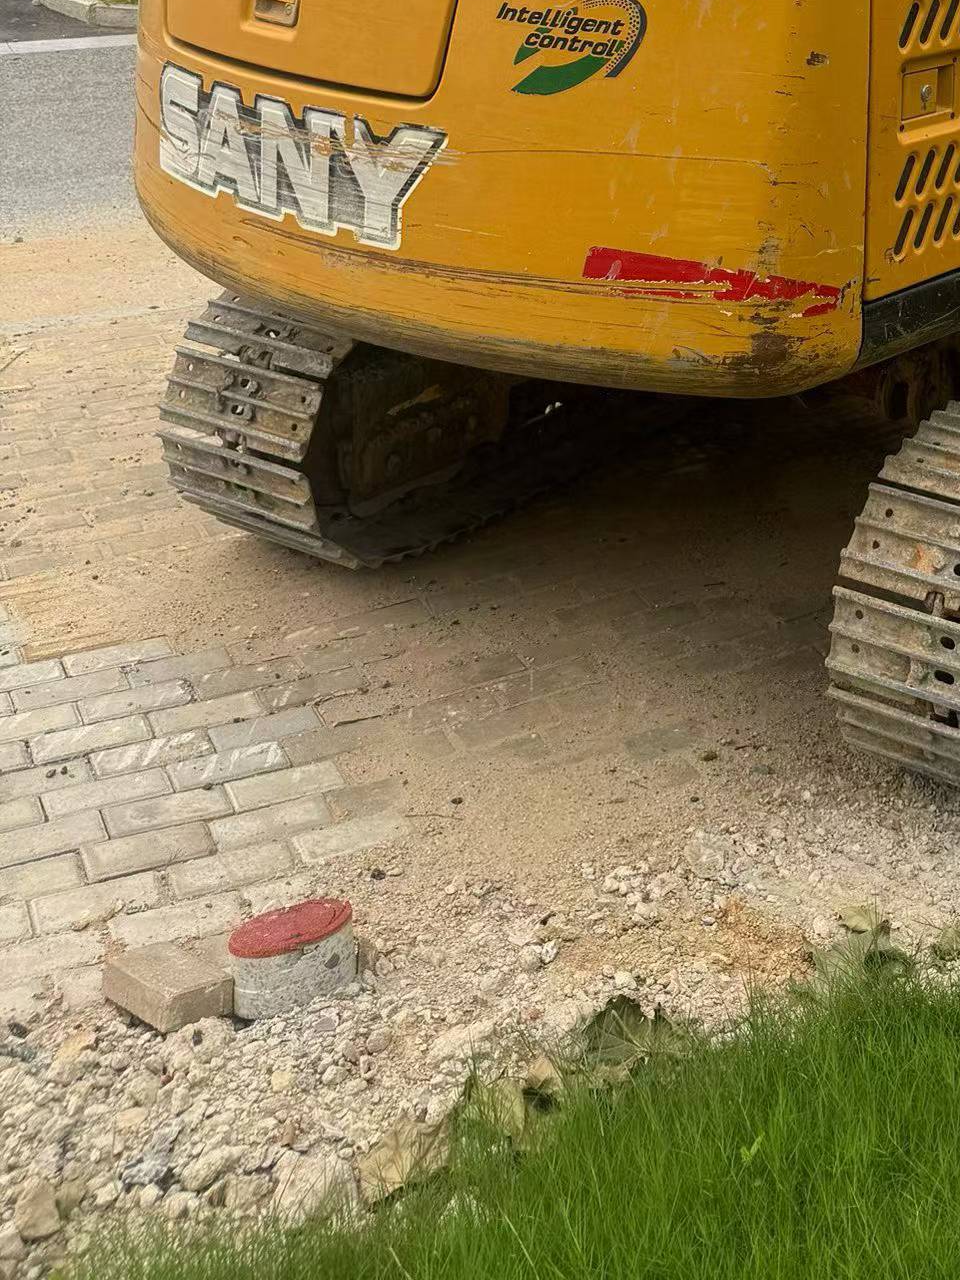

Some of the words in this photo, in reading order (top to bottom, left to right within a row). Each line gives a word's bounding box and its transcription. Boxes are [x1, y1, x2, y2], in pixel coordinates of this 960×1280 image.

[496, 1, 625, 36] Intelligent
[523, 31, 618, 58] control
[160, 60, 449, 250] SANY
